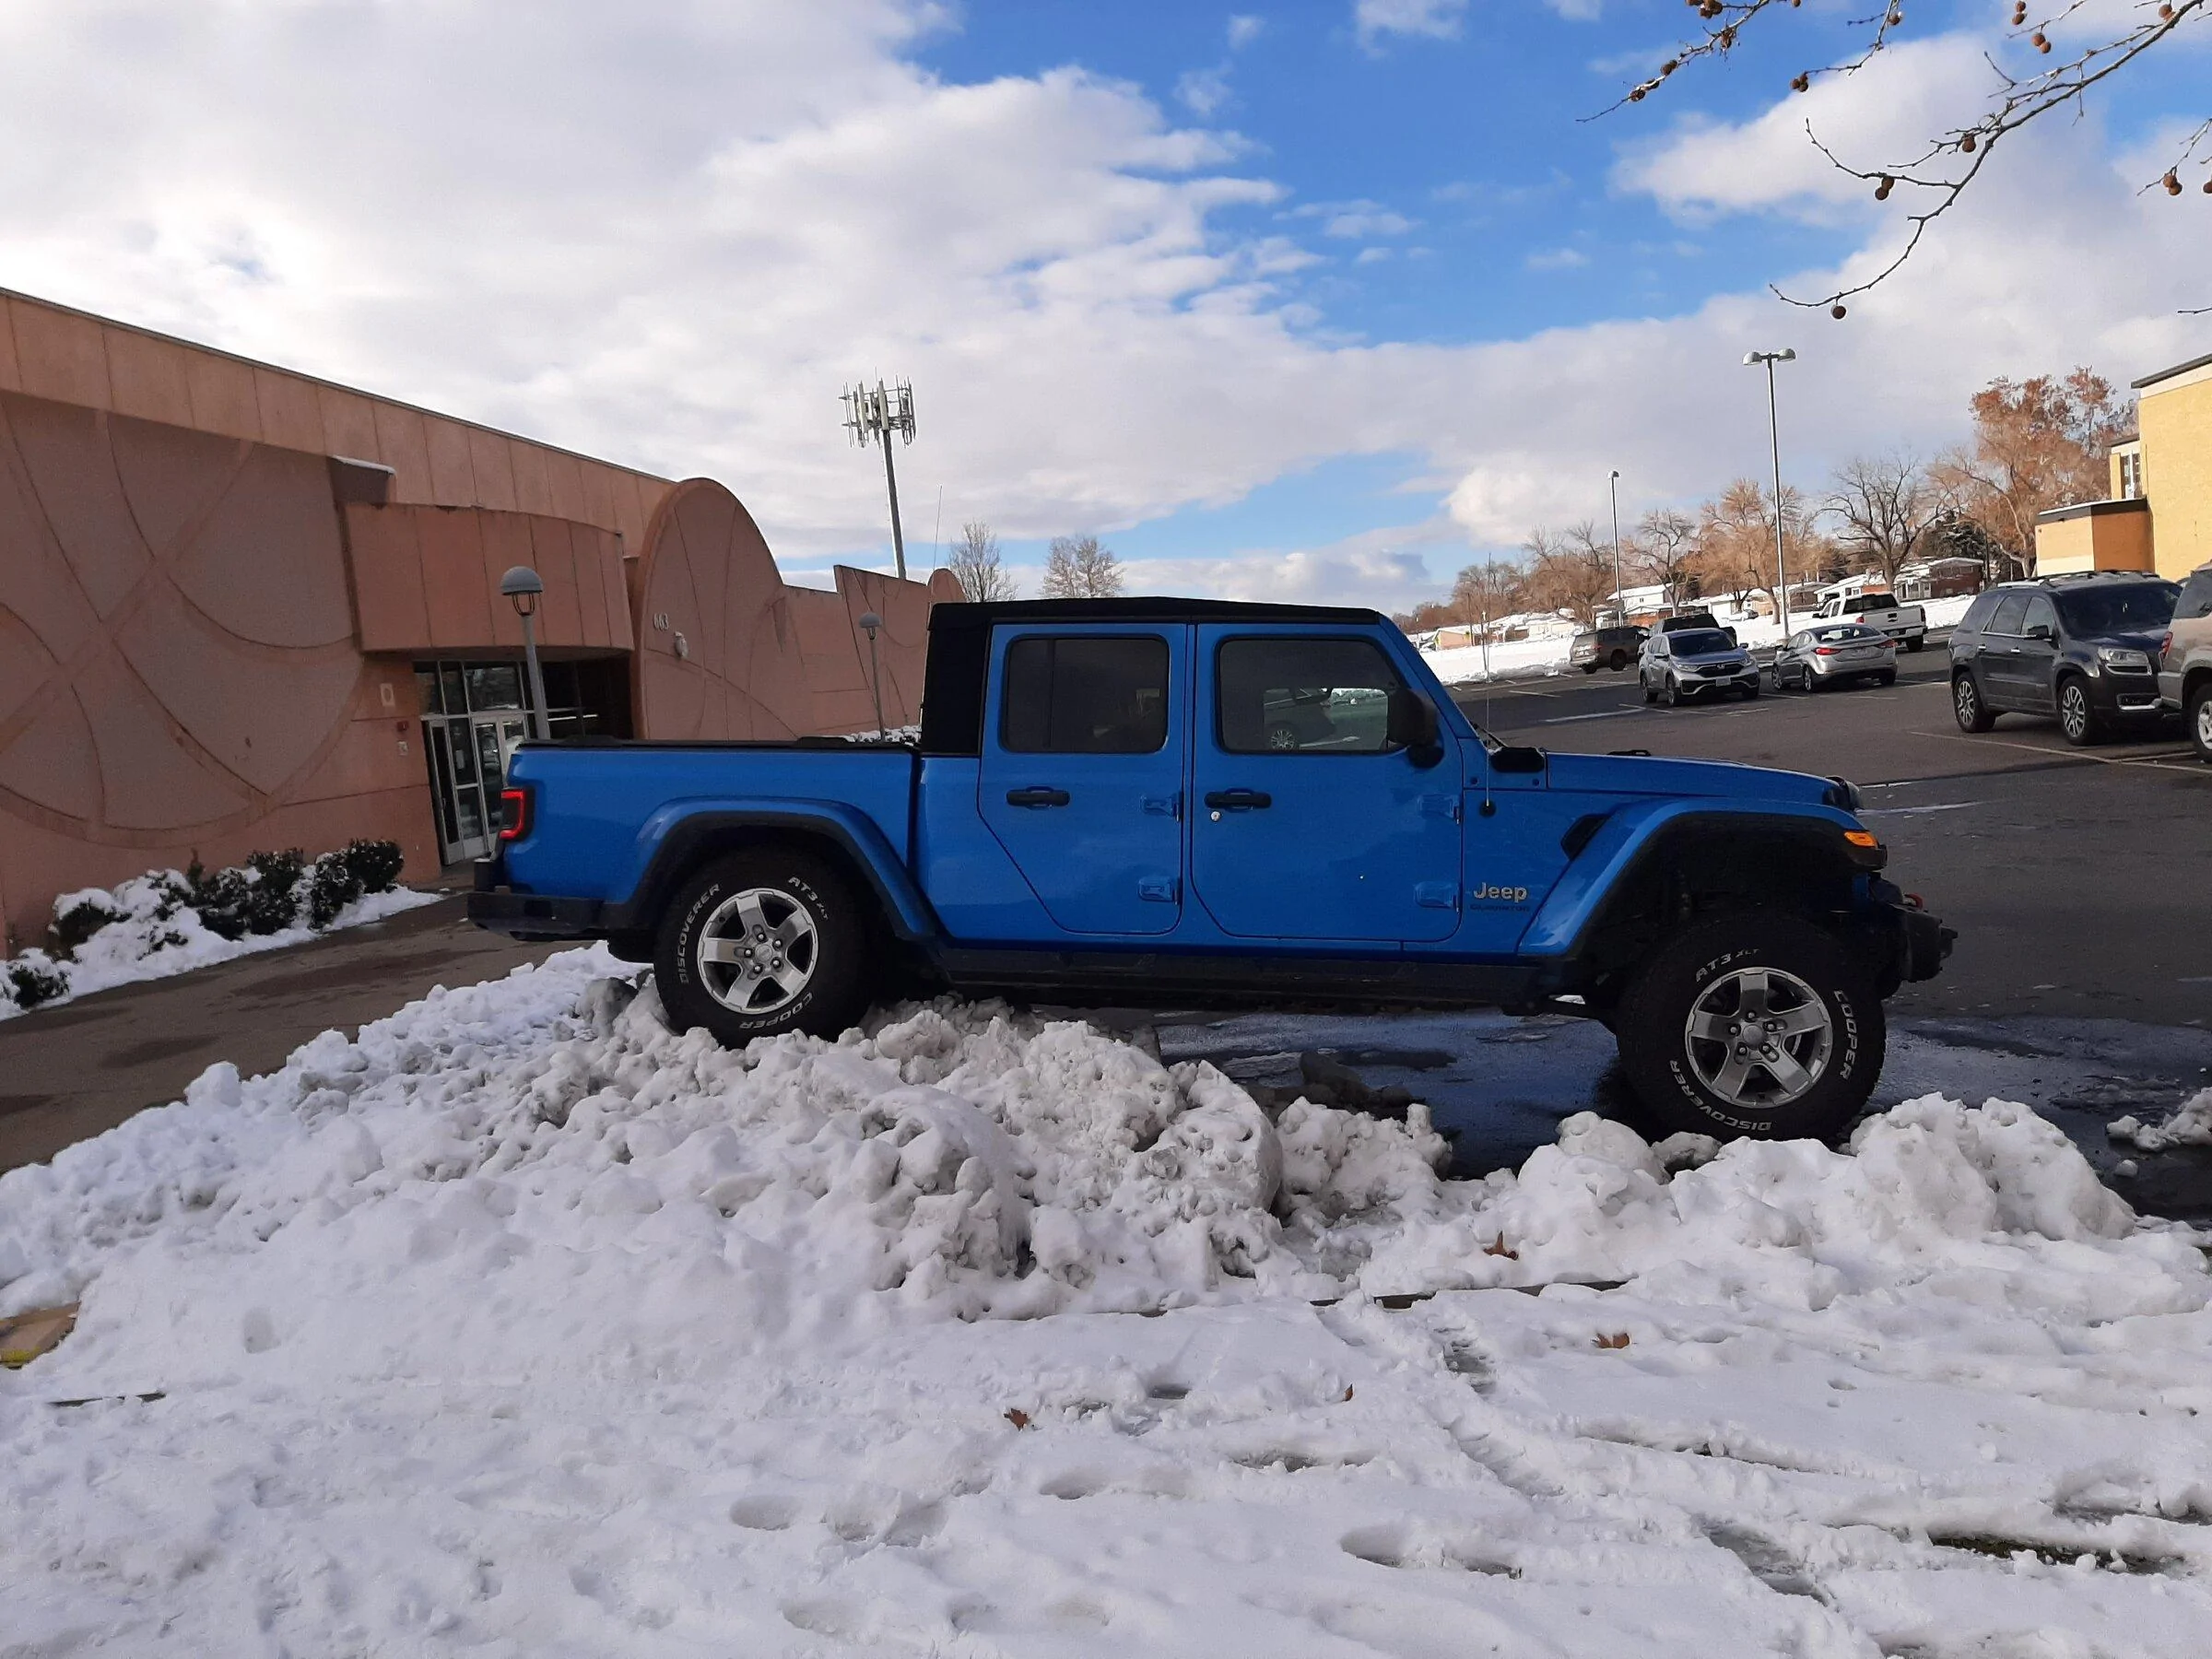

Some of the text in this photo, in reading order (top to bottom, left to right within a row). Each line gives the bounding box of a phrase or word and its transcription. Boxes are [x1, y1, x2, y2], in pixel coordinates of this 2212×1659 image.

[788, 877, 818, 901] AT3
[1473, 882, 1527, 902] Jeep
[677, 883, 720, 984] DISCOVERER
[1696, 953, 1732, 982] AT3
[739, 992, 813, 1029] COOPER
[1833, 990, 1858, 1080] COOPER
[1669, 1059, 1772, 1131] DISCOVERER
